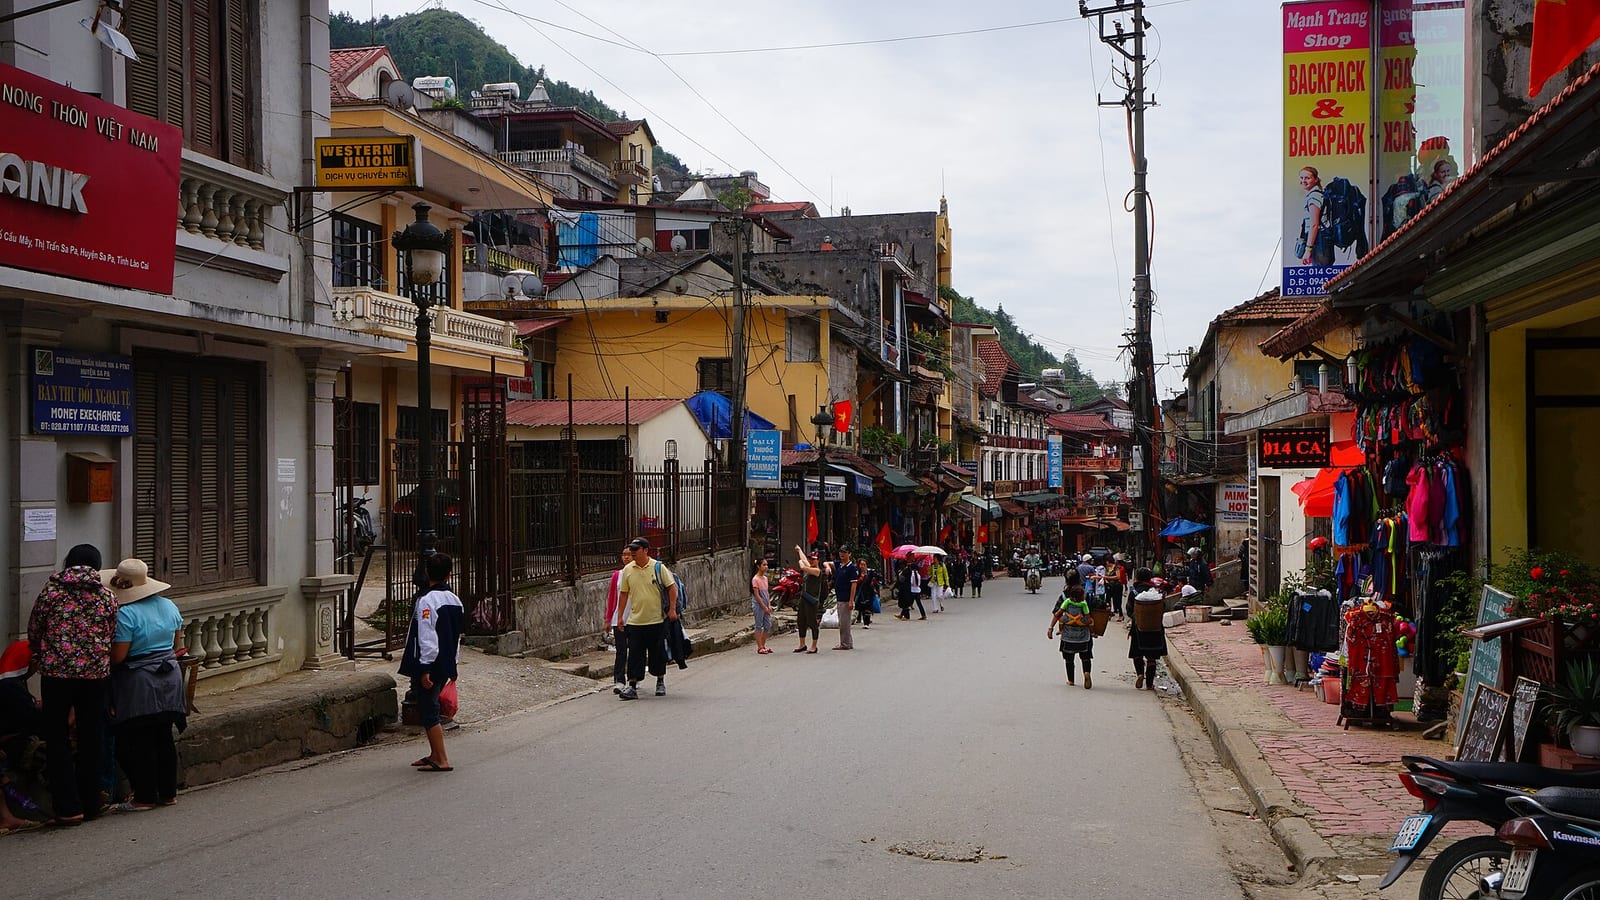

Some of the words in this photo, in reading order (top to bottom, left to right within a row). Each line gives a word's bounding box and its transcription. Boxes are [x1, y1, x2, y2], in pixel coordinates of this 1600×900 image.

[1287, 11, 1323, 31] Mạnh
[1328, 9, 1368, 28] Trang
[1304, 34, 1352, 48] Shop
[1289, 60, 1366, 95] BACKPACK
[1311, 98, 1345, 119] &
[52, 101, 89, 129] THÔN
[97, 116, 124, 141] VIỆT
[130, 128, 158, 152] NAM
[1289, 123, 1366, 157] BACKPACK
[321, 144, 393, 157] WESTERN
[344, 155, 393, 167] UNION
[325, 173, 344, 182] DỊCH
[345, 172, 356, 182] VỤ
[60, 243, 68, 254] Sa
[51, 407, 78, 420] MONEY
[79, 408, 122, 422] EXECHANGE
[1264, 441, 1292, 456] 014
[1296, 440, 1324, 455] CA
[748, 462, 778, 472] PHARMACY
[1228, 502, 1249, 512] HOT
